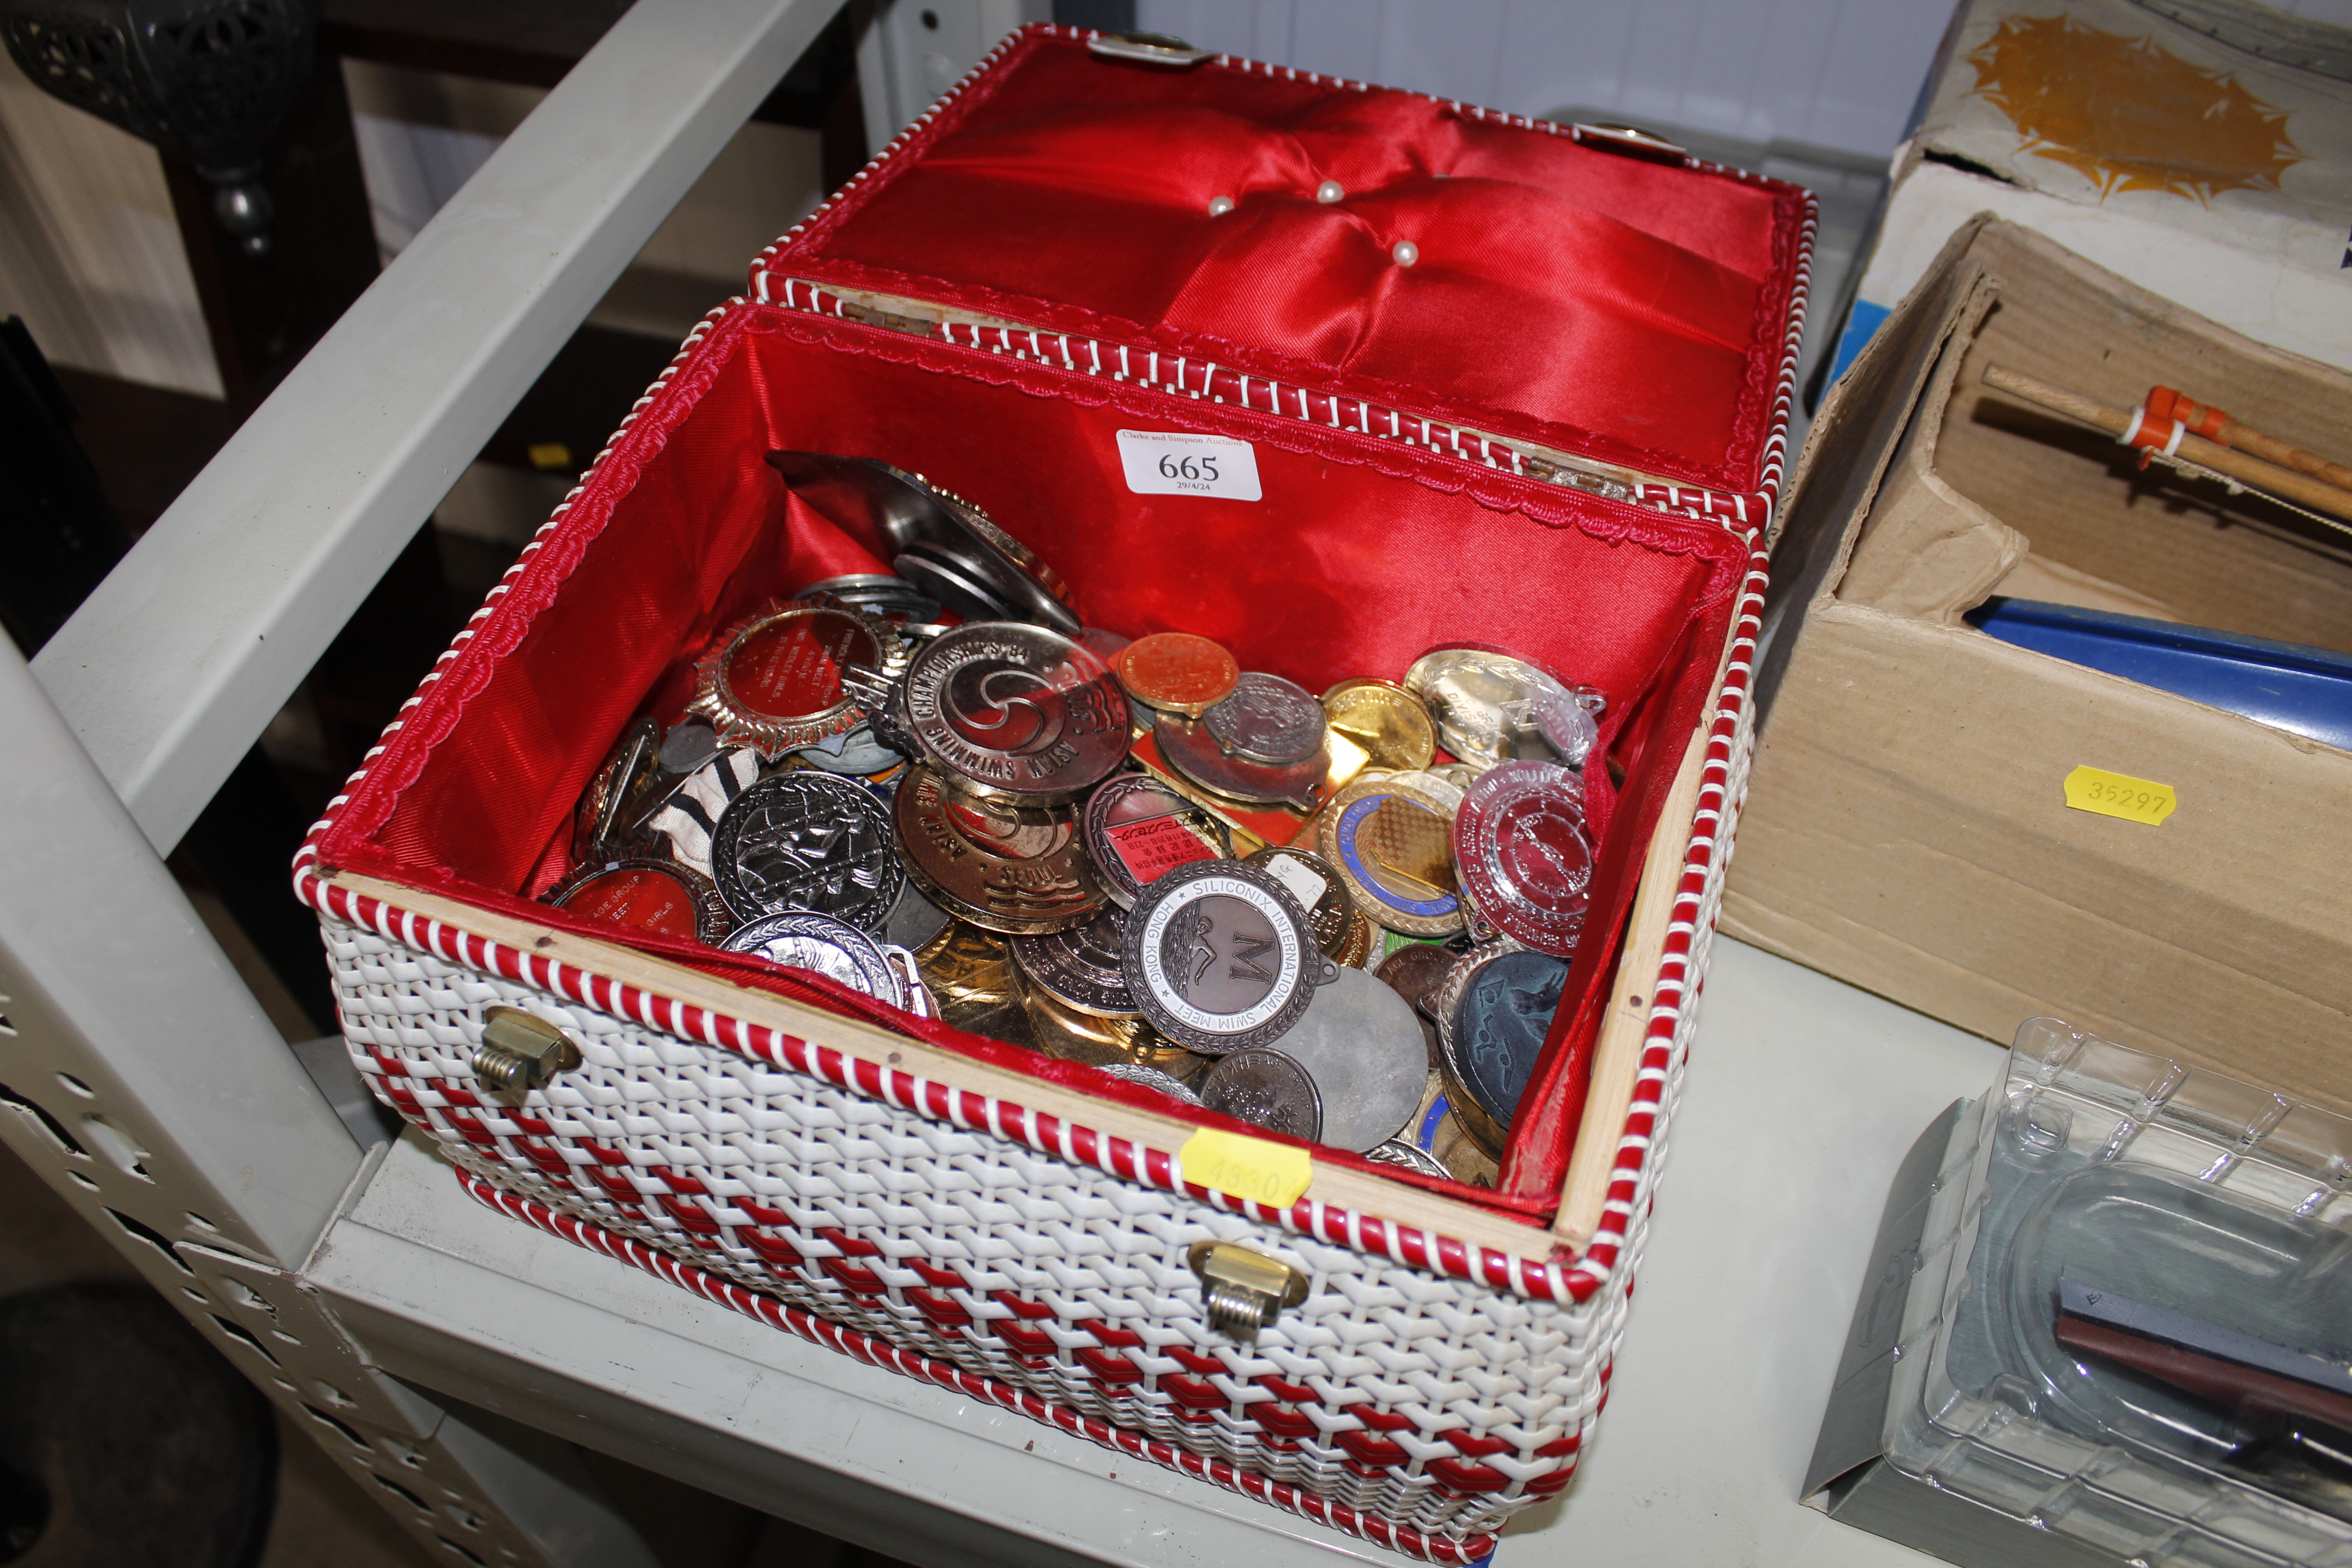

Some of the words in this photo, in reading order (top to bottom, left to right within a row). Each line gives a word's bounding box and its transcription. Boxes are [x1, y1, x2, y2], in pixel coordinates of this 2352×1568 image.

[1122, 431, 1149, 440] Clarke
[1168, 435, 1203, 444] Simpson
[1206, 436, 1243, 446] Auctions
[1159, 454, 1219, 481] 665
[1177, 481, 1210, 491] 29/4/24
[782, 646, 800, 674] MEDLEY
[772, 676, 788, 698] GIRLS
[811, 666, 825, 686] MEET
[926, 727, 1017, 779] SWIMMING
[2087, 782, 2167, 813] 35297
[593, 901, 612, 918] AGE
[611, 875, 640, 902] GROUP
[1192, 880, 1272, 910] SILICONIX
[646, 902, 674, 926] GIRLS
[1147, 902, 1175, 939] HONG
[1145, 944, 1162, 984] KONG
[1259, 910, 1297, 1014] INTERNATIONAL
[1174, 1004, 1212, 1027] MEET
[1218, 1012, 1257, 1029] SWIM
